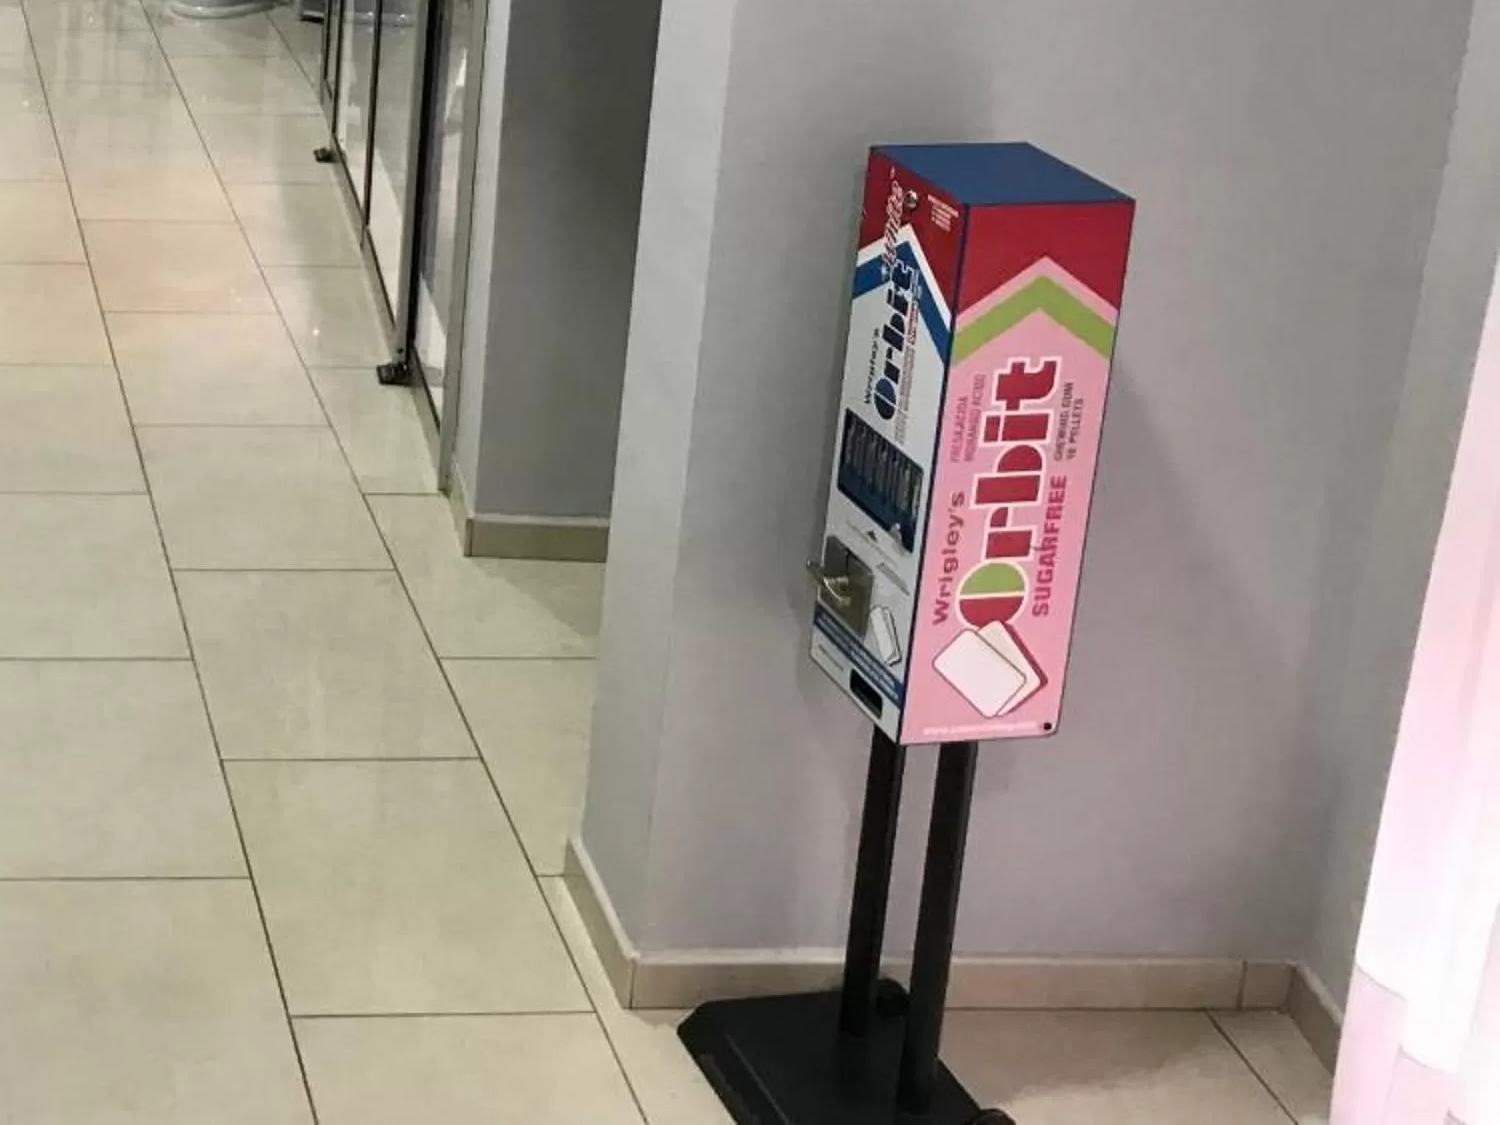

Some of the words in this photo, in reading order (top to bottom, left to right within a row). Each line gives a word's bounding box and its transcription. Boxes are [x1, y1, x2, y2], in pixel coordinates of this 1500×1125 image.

[863, 328, 879, 405] Wrigley's
[873, 260, 913, 421] Orbit
[1053, 411, 1069, 462] CHEWING
[1061, 382, 1074, 408] GUM
[1068, 398, 1084, 444] PELLETS
[931, 491, 966, 626] Wrigley's
[957, 357, 1060, 628] Orbit
[1031, 474, 1068, 618] SUGARFREE
